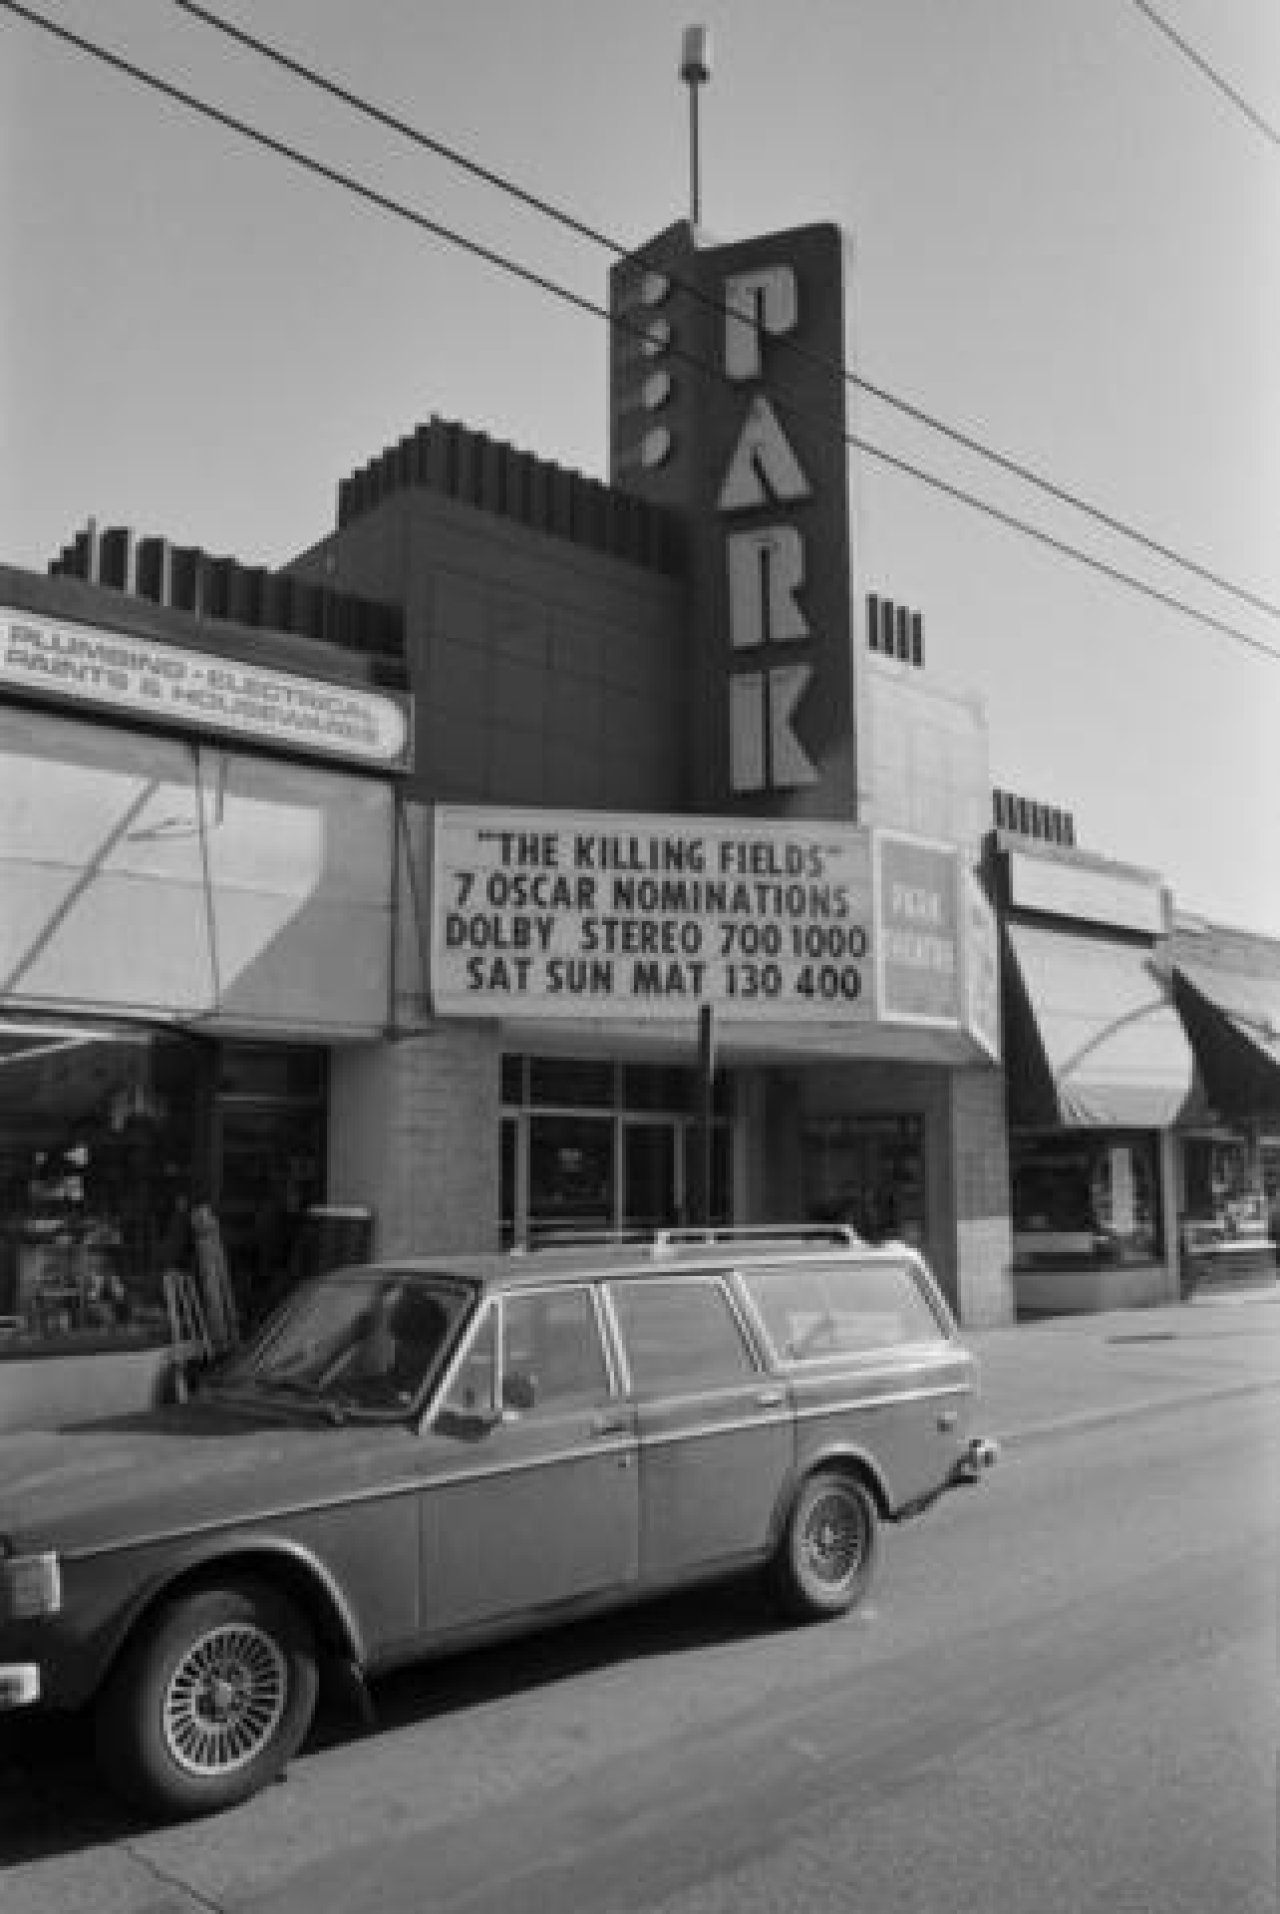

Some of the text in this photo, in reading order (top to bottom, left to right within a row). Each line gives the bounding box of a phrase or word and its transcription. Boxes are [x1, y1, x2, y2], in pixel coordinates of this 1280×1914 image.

[717, 265, 823, 790] PARK
[6, 648, 128, 691] PAINTS
[10, 624, 188, 680] PLUMBING
[574, 836, 703, 872] KILLING
[455, 872, 474, 906] 7
[486, 873, 595, 910] OSCAR
[613, 880, 849, 917] NOMINATIONS
[446, 913, 555, 949] DOLBY
[581, 917, 702, 953] STEREO
[719, 924, 781, 956] 700
[792, 925, 867, 958] 1000
[466, 956, 862, 999] SAT SUN MAT 130 400
